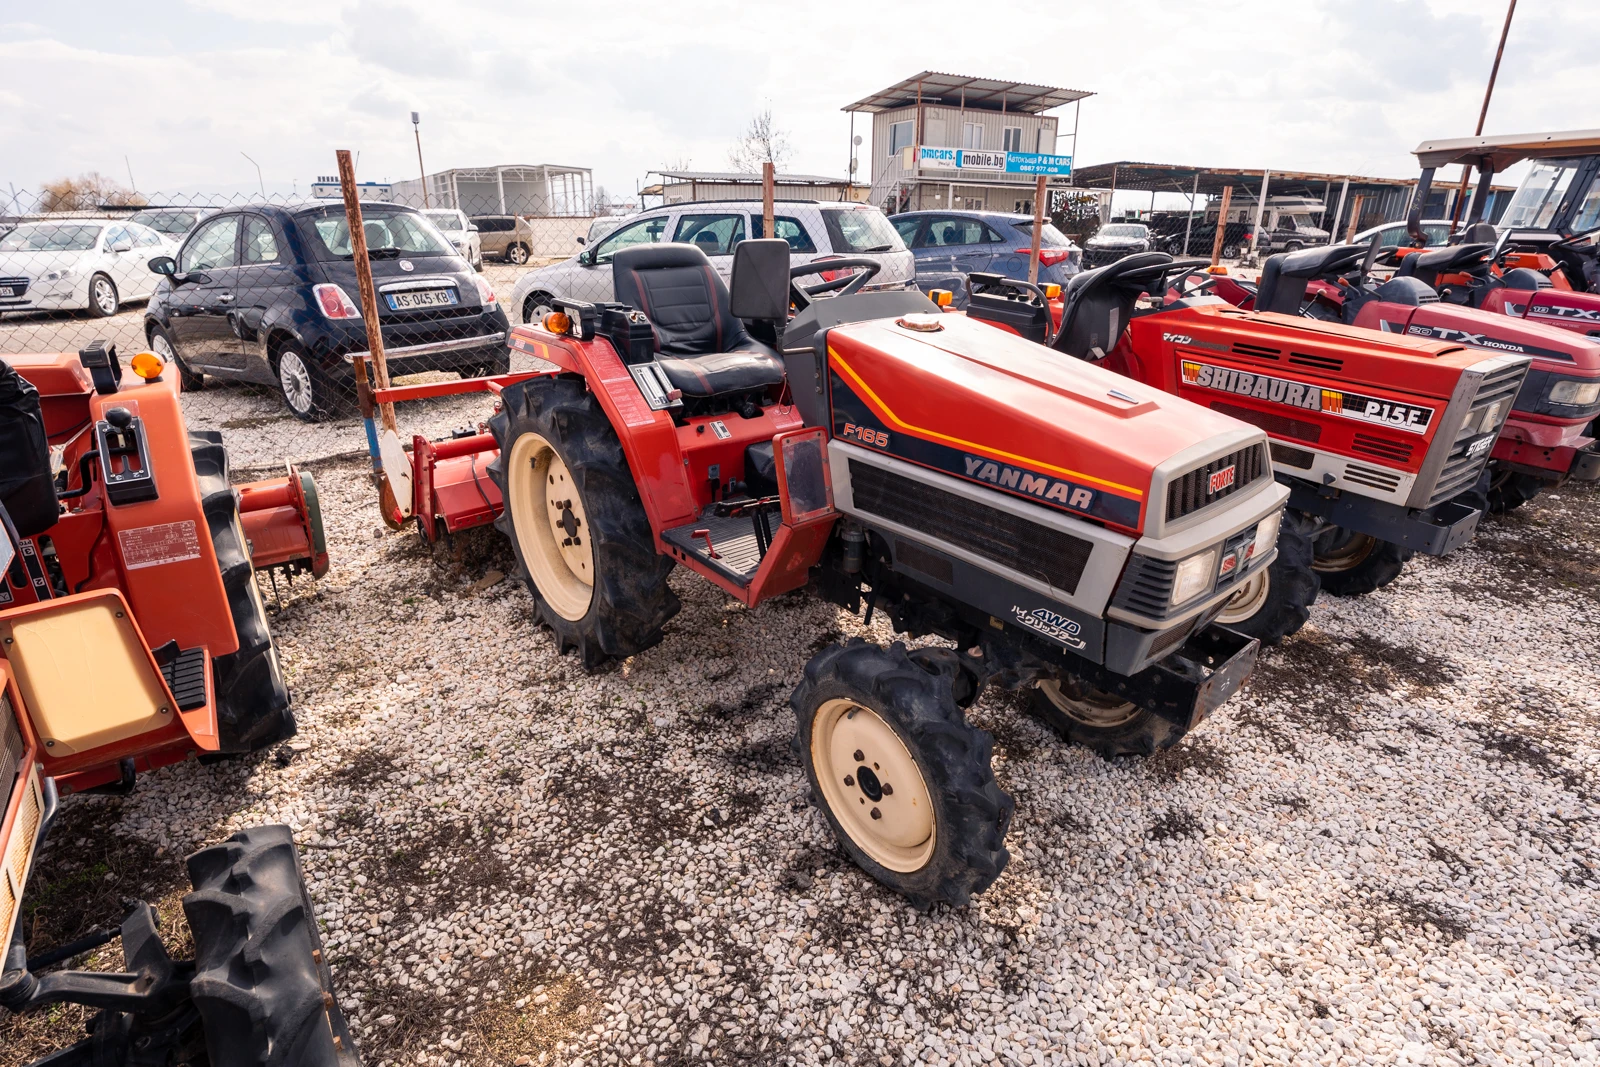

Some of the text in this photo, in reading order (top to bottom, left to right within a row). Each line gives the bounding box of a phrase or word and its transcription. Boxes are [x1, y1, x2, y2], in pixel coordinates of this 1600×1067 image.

[963, 152, 1004, 168] mobile.bg
[1038, 156, 1042, 164] P
[1042, 156, 1047, 165] &
[1048, 157, 1054, 165] M
[1055, 158, 1071, 166] CARS
[395, 292, 449, 307] AS-045-KB
[1551, 305, 1598, 320] TX
[1162, 332, 1192, 344] マイコン
[1433, 326, 1486, 345] TX
[1482, 340, 1524, 353] HONDA
[1197, 364, 1322, 412] SHIBAURA
[1363, 400, 1421, 427] P15F
[843, 423, 889, 448] F165
[964, 456, 1094, 510] YANMAR
[1209, 465, 1235, 495] FORTE
[1032, 608, 1081, 635] 4WD
